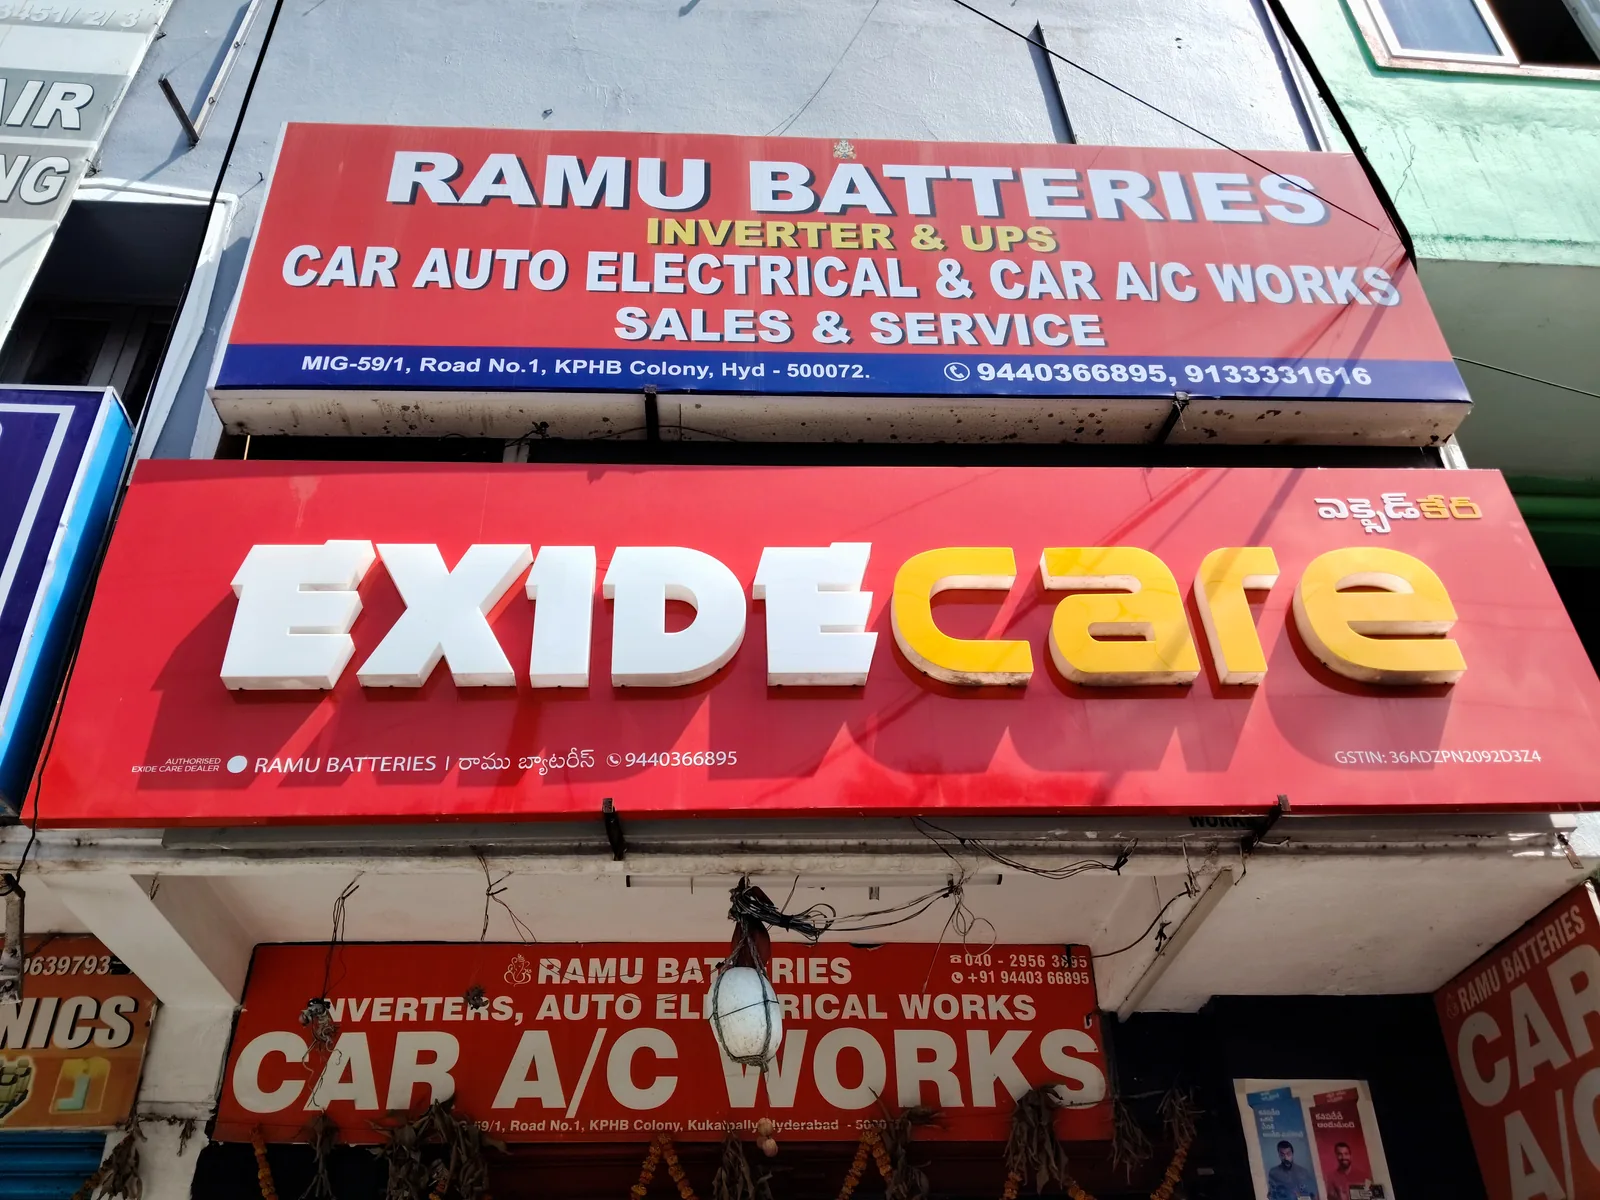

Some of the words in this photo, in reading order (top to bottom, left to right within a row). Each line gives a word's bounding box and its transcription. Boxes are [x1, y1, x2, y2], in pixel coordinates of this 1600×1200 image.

[386, 151, 706, 210] RAMU
[750, 160, 1327, 224] BATTERIES
[647, 218, 894, 249] INVERTER
[911, 222, 945, 251] &
[961, 225, 1057, 253] UPS
[282, 245, 398, 288] CAR
[412, 248, 567, 290] AUTO
[586, 251, 918, 300] ELECTRICAL
[936, 258, 974, 300] &
[990, 260, 1102, 301] CAR
[1116, 262, 1198, 303] A/C
[1206, 264, 1400, 308] WORKS
[615, 306, 792, 343] SALES
[812, 311, 851, 345] &
[870, 312, 1105, 348] SERVICE
[301, 355, 412, 376] MIG-59/1,
[420, 357, 478, 374] Road
[488, 359, 547, 377] No.1,
[555, 360, 622, 375] KPHB
[630, 360, 714, 380] Colony,
[722, 363, 766, 380] Hyd
[787, 363, 870, 380] 500072.
[977, 363, 1177, 386] 9440366895,
[1185, 365, 1372, 386] 9133331616
[131, 765, 157, 773] EXIDE
[158, 765, 183, 773] CARE
[184, 764, 220, 772] DEALER
[165, 757, 221, 765] AUTHORISED
[254, 756, 320, 774] RAMU
[327, 754, 437, 773] BATTERIES
[625, 751, 738, 767] 9440366895
[1335, 750, 1388, 764] GSTIN:
[1391, 750, 1543, 764] 36ADZPN2092D3Z4
[538, 957, 644, 985] RAMU
[657, 957, 852, 984] BATRIES
[964, 954, 992, 967] 040
[1010, 954, 1046, 968] 2956
[1458, 964, 1501, 1014] RAMU
[1501, 904, 1586, 984] BATTERIES
[968, 971, 995, 983] +91
[1001, 971, 1043, 984] 94403
[1047, 971, 1090, 985] 66895
[325, 994, 524, 1026] NVERTERS,
[536, 995, 641, 1020] AUTO
[656, 994, 888, 1021] ELRICAL
[900, 994, 1037, 1021] WORKS
[232, 1030, 460, 1114] CAR
[491, 1026, 680, 1120] A/C
[718, 1027, 1106, 1110] WORKS
[510, 1120, 545, 1131] Road
[550, 1120, 584, 1133] No.1,
[589, 1120, 629, 1131] KPHB
[633, 1120, 683, 1133] Colony,
